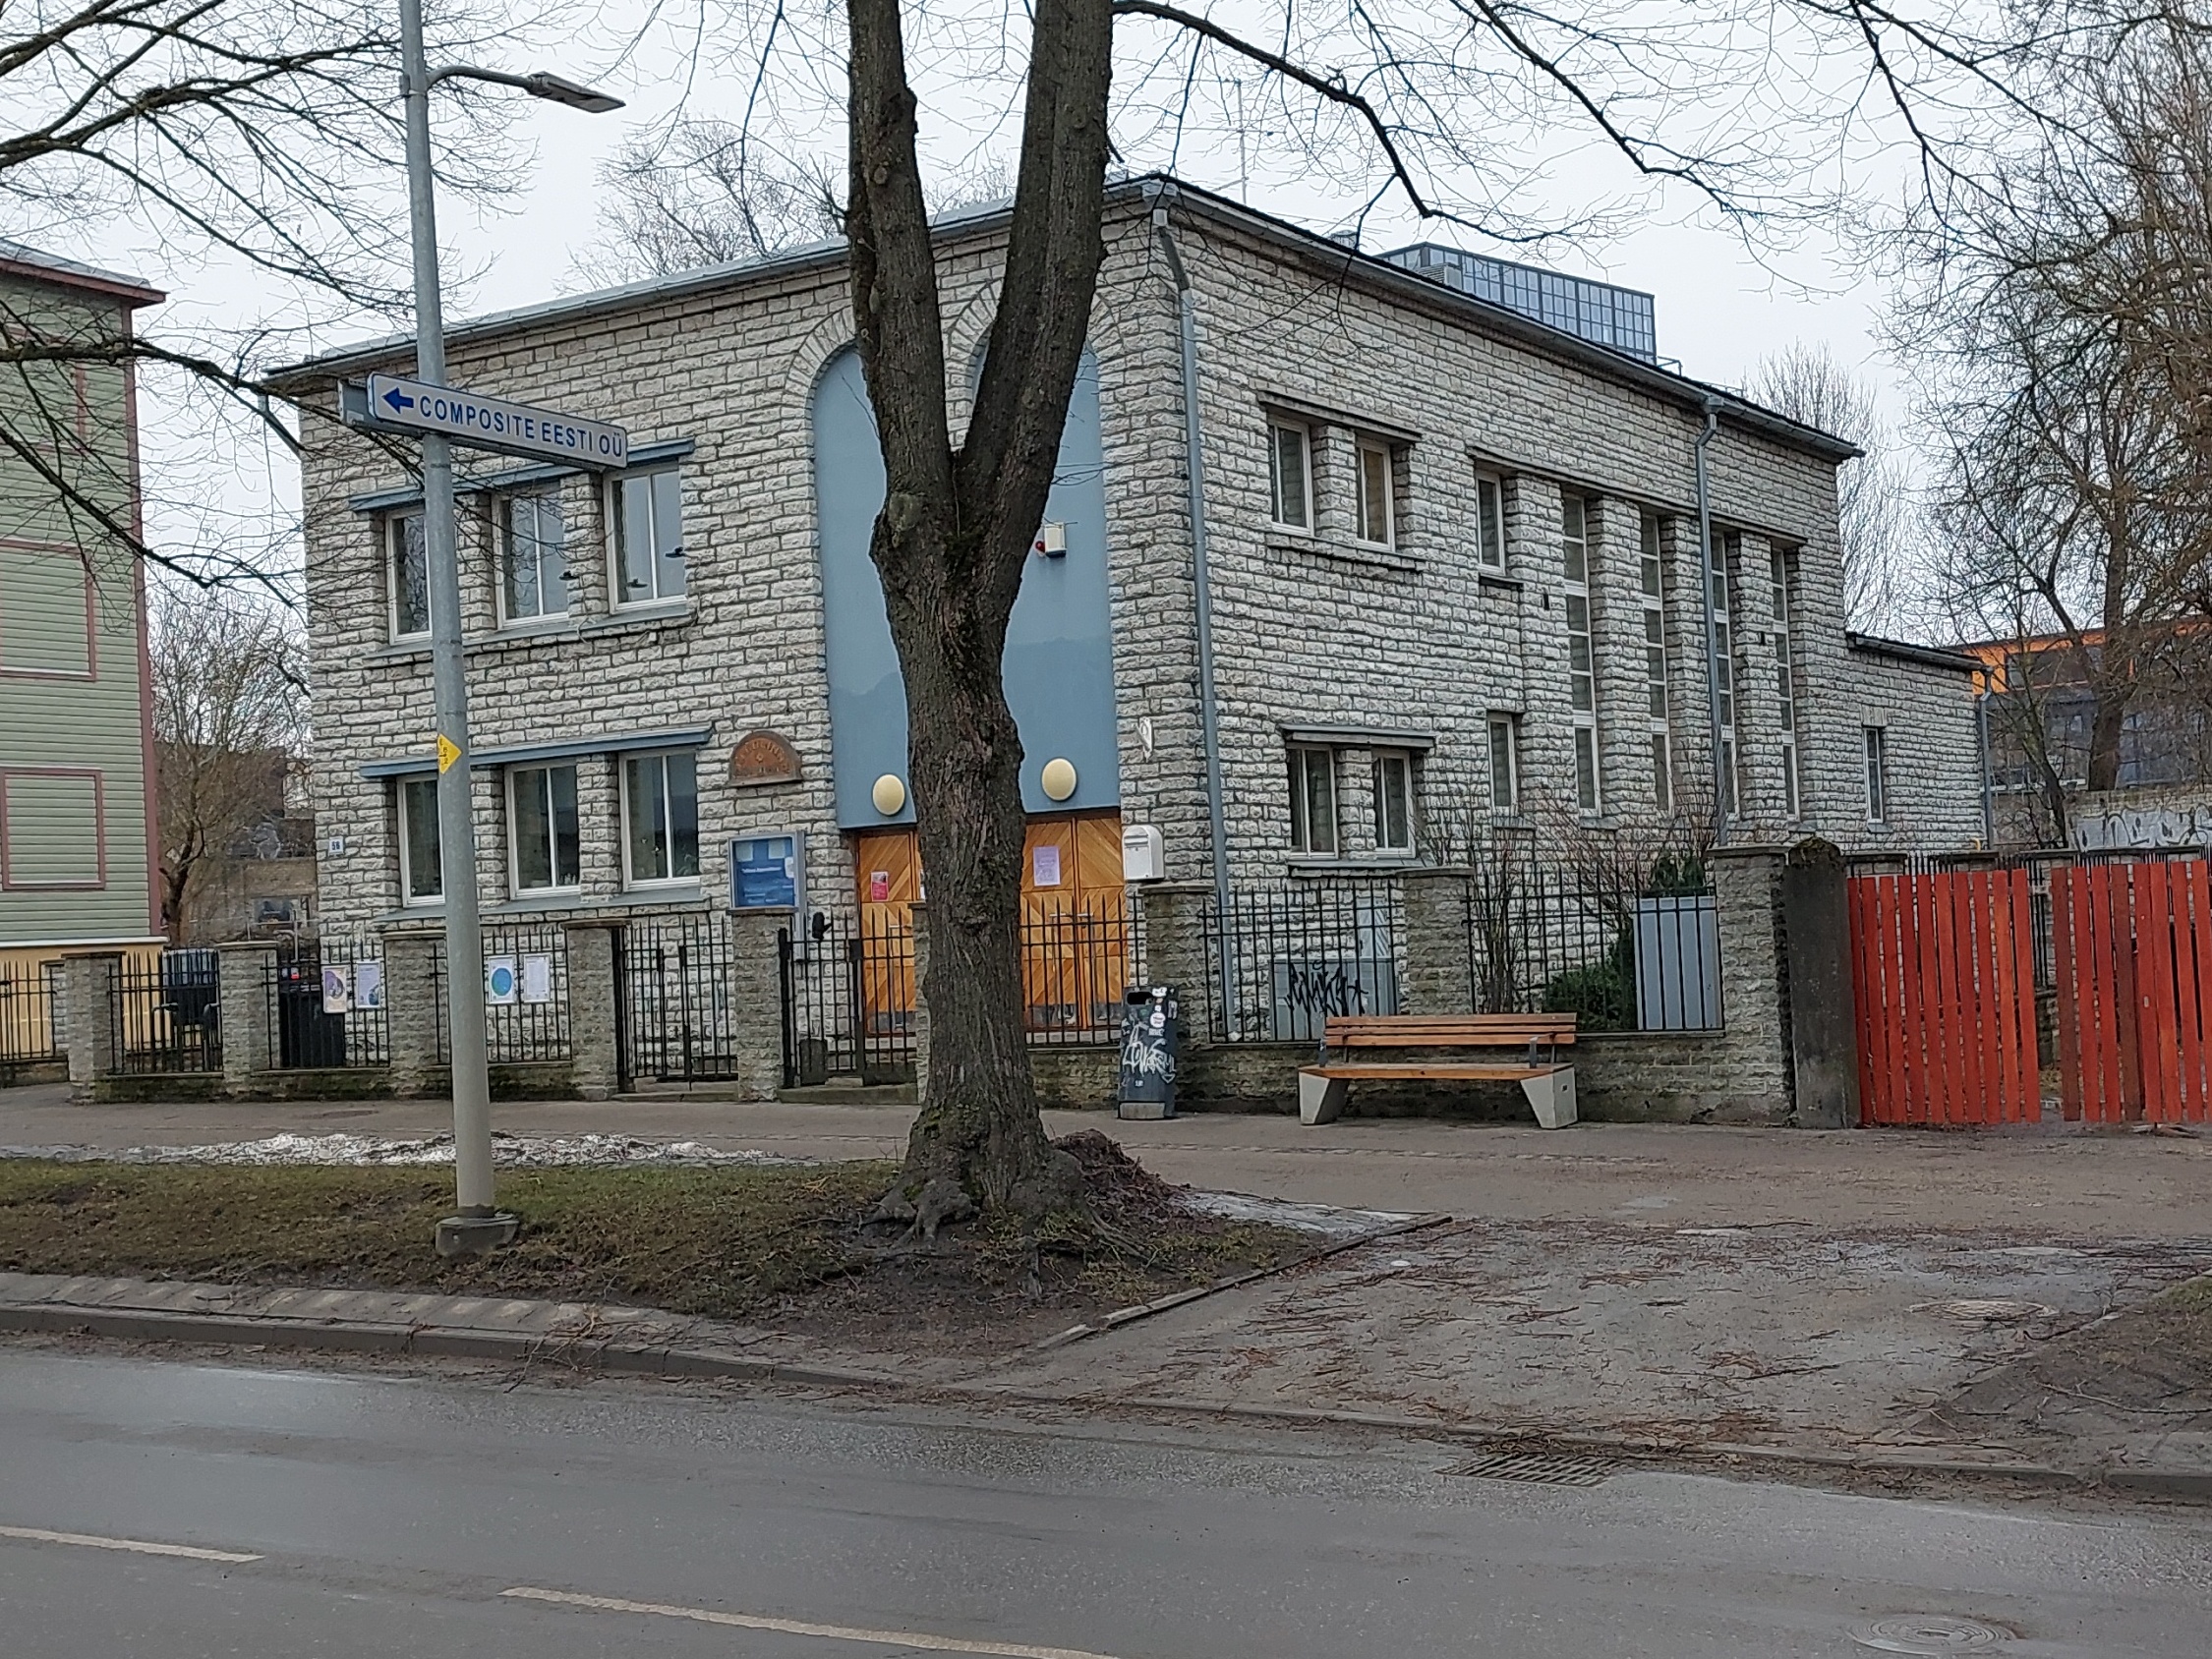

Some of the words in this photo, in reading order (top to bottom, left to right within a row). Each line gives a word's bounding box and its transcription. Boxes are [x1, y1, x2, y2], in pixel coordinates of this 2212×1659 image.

[420, 395, 535, 439] COMPOSITE
[542, 422, 593, 452] EESTI
[599, 431, 622, 458] OÜ
